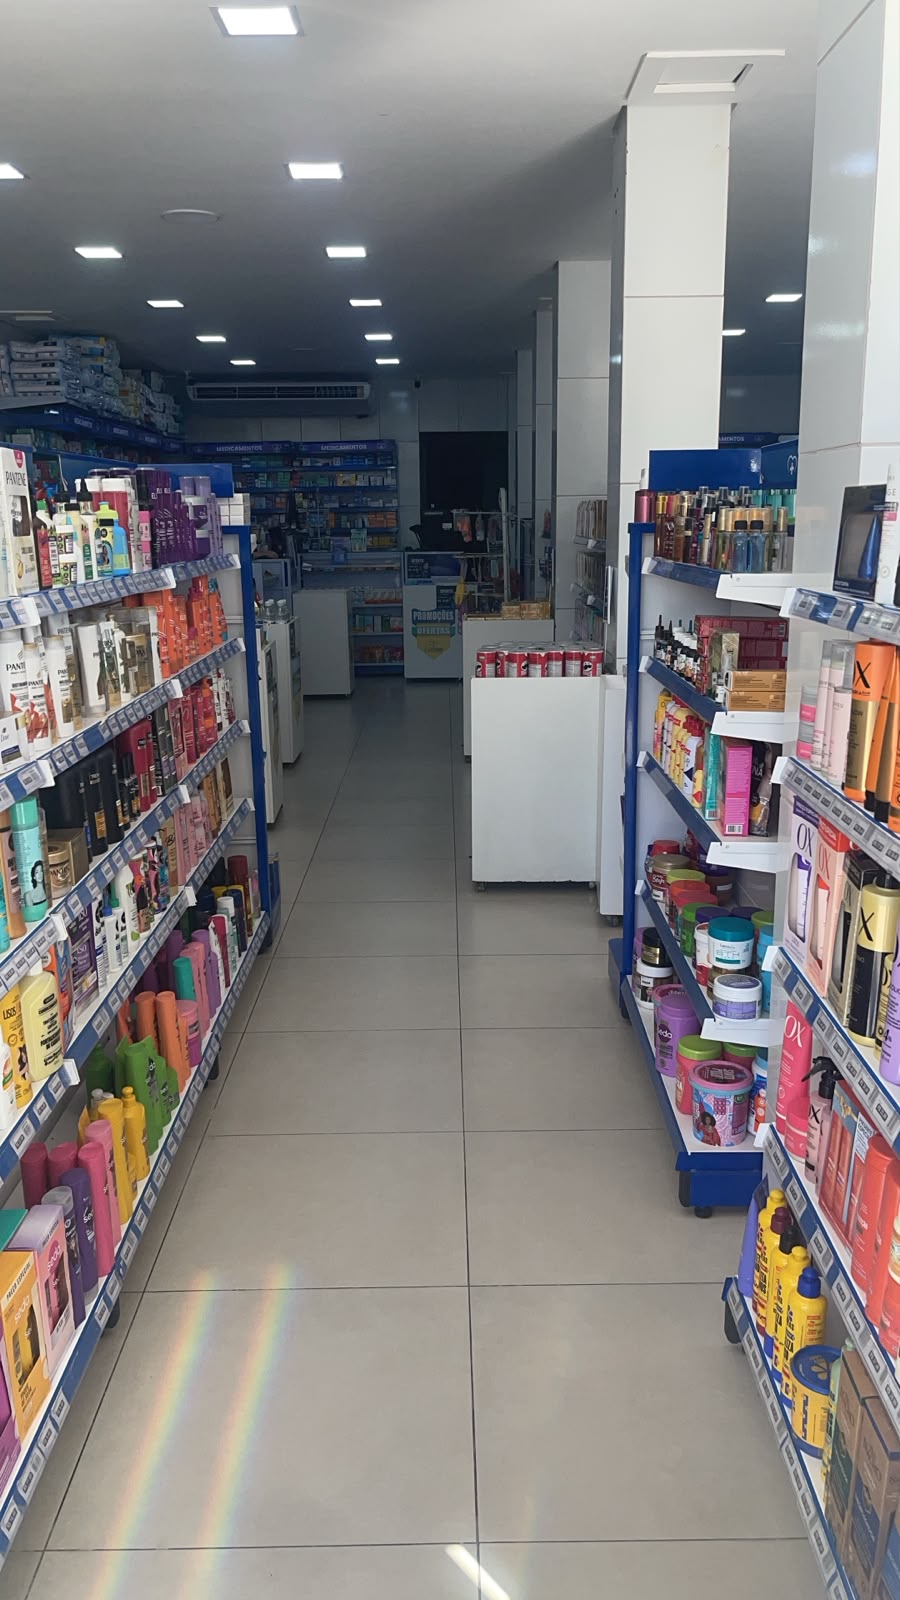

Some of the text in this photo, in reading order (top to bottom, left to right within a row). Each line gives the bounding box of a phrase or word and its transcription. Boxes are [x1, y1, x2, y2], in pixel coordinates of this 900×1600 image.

[216, 444, 263, 452] MEDICAMENTOS
[320, 443, 368, 451] MEDICAMENTOS
[6, 471, 27, 487] PANTENE
[413, 609, 454, 622] PROMOÇÕES
[797, 822, 816, 858] OX
[784, 1014, 807, 1049] OX
